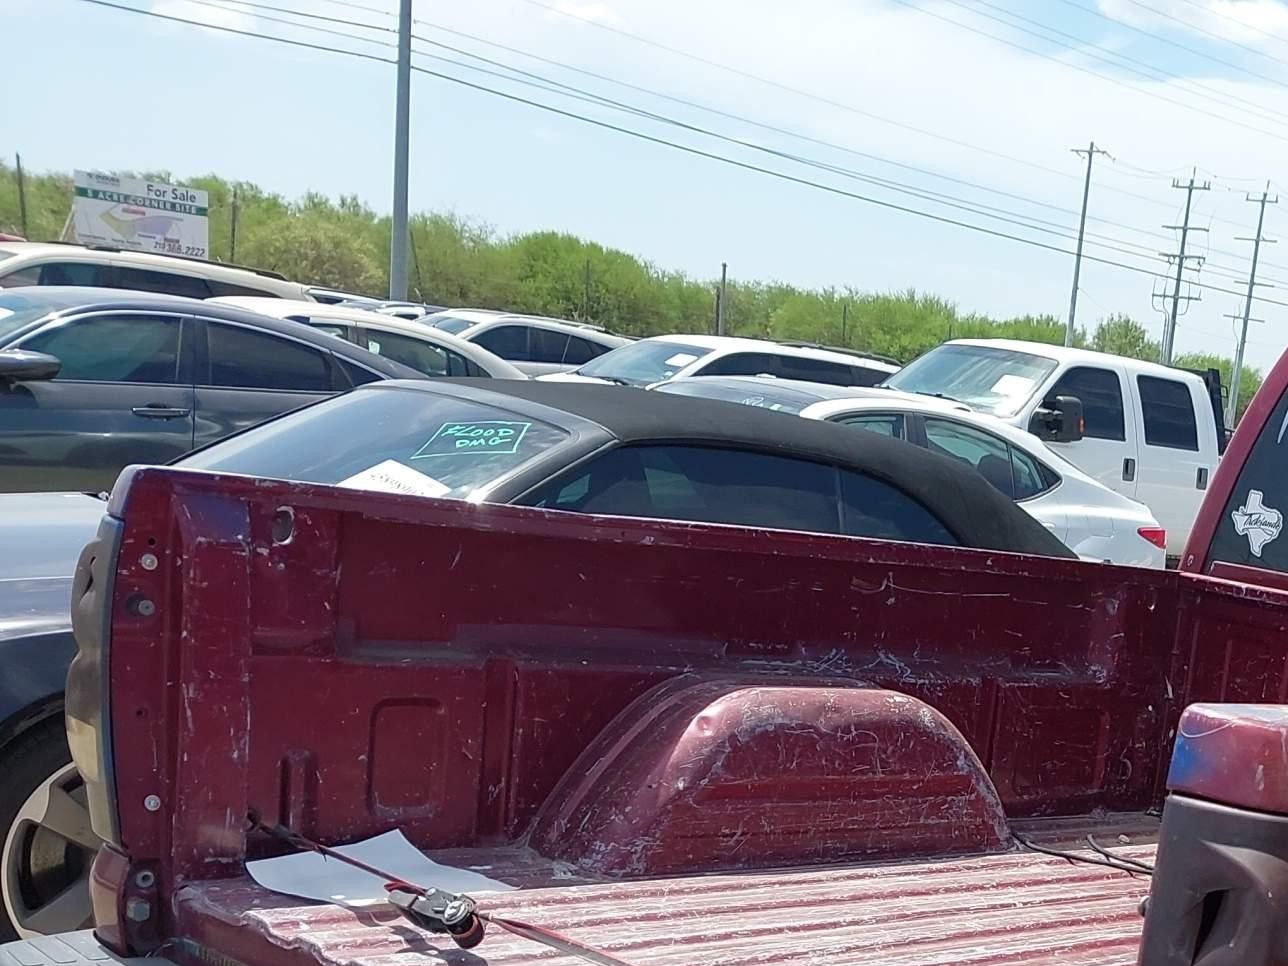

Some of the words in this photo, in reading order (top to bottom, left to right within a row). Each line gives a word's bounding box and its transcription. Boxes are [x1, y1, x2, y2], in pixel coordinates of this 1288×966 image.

[146, 184, 167, 199] For
[171, 188, 197, 203] Sale
[97, 191, 125, 203] ACRE
[128, 196, 172, 210] CORNER
[175, 204, 197, 214] SITE
[441, 425, 515, 437] FLOOD
[455, 437, 512, 449] DMG
